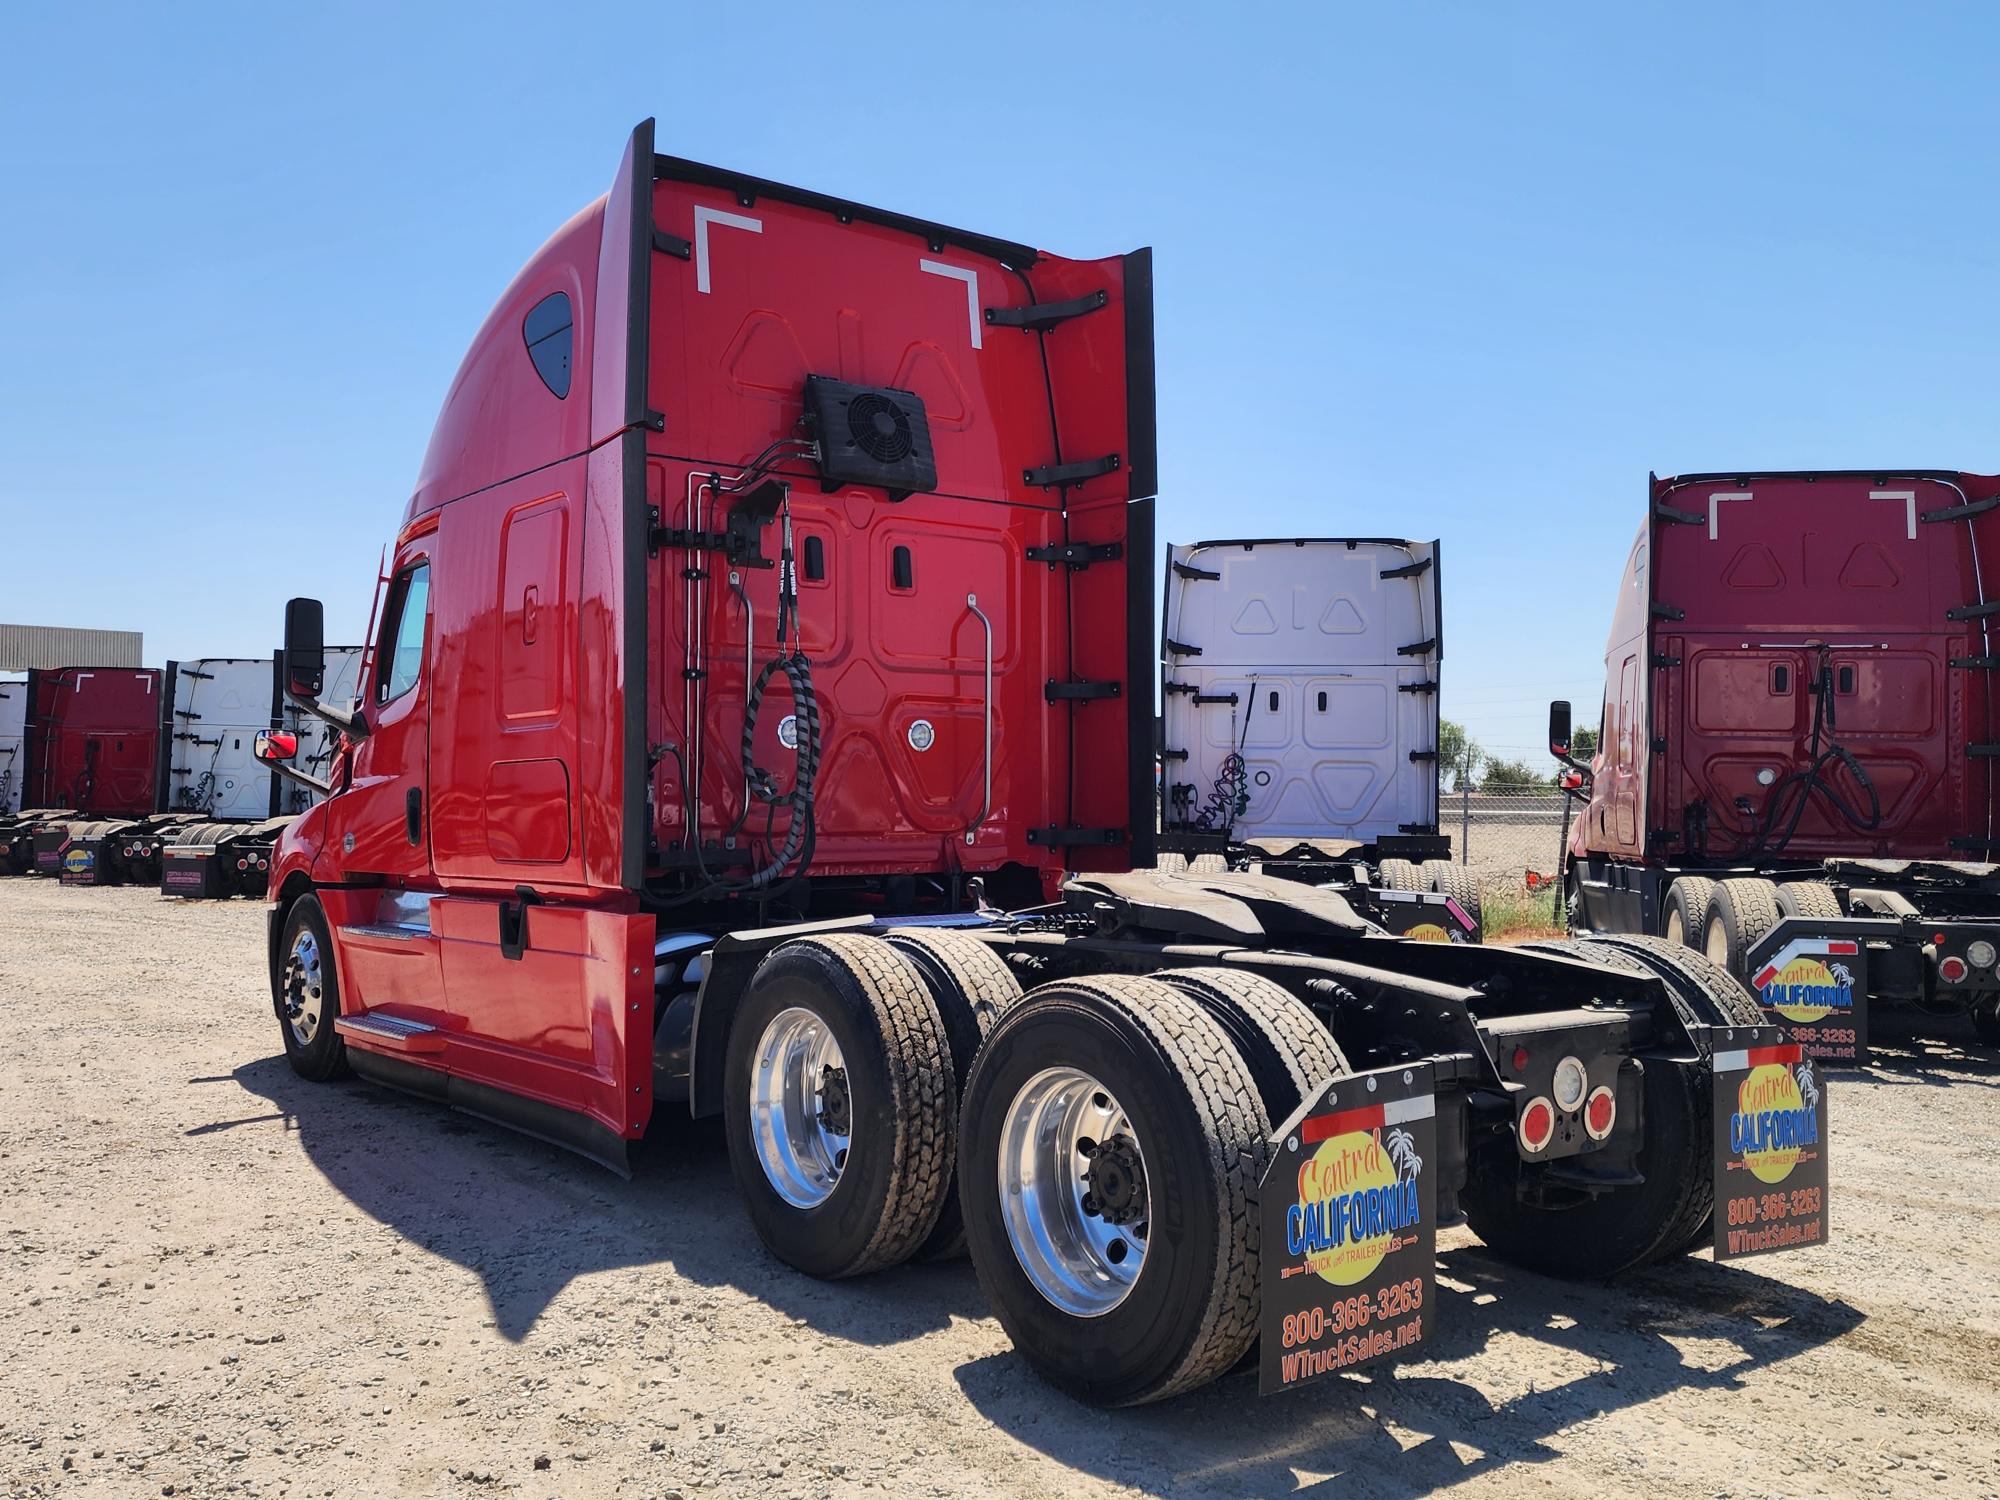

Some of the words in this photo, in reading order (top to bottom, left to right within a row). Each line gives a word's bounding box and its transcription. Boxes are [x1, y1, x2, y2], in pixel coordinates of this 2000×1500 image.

[1762, 984, 1853, 1007] CALIFORNIA
[1772, 960, 1828, 985] entral
[1738, 1063, 1794, 1113] Central
[1731, 1107, 1819, 1154] CALIFORNIA
[1298, 1127, 1383, 1205] Central
[1287, 1178, 1420, 1255] CALIFORNIA
[1728, 1187, 1821, 1226] 800-366-3263
[1303, 1255, 1331, 1275] TRUCK
[1346, 1245, 1377, 1263] TRAILER
[1379, 1237, 1403, 1254] SALES
[1728, 1218, 1821, 1255] WTruckSales.net
[1282, 1277, 1423, 1348] 800-366-3263
[1281, 1315, 1423, 1385] WTruckSales.net
